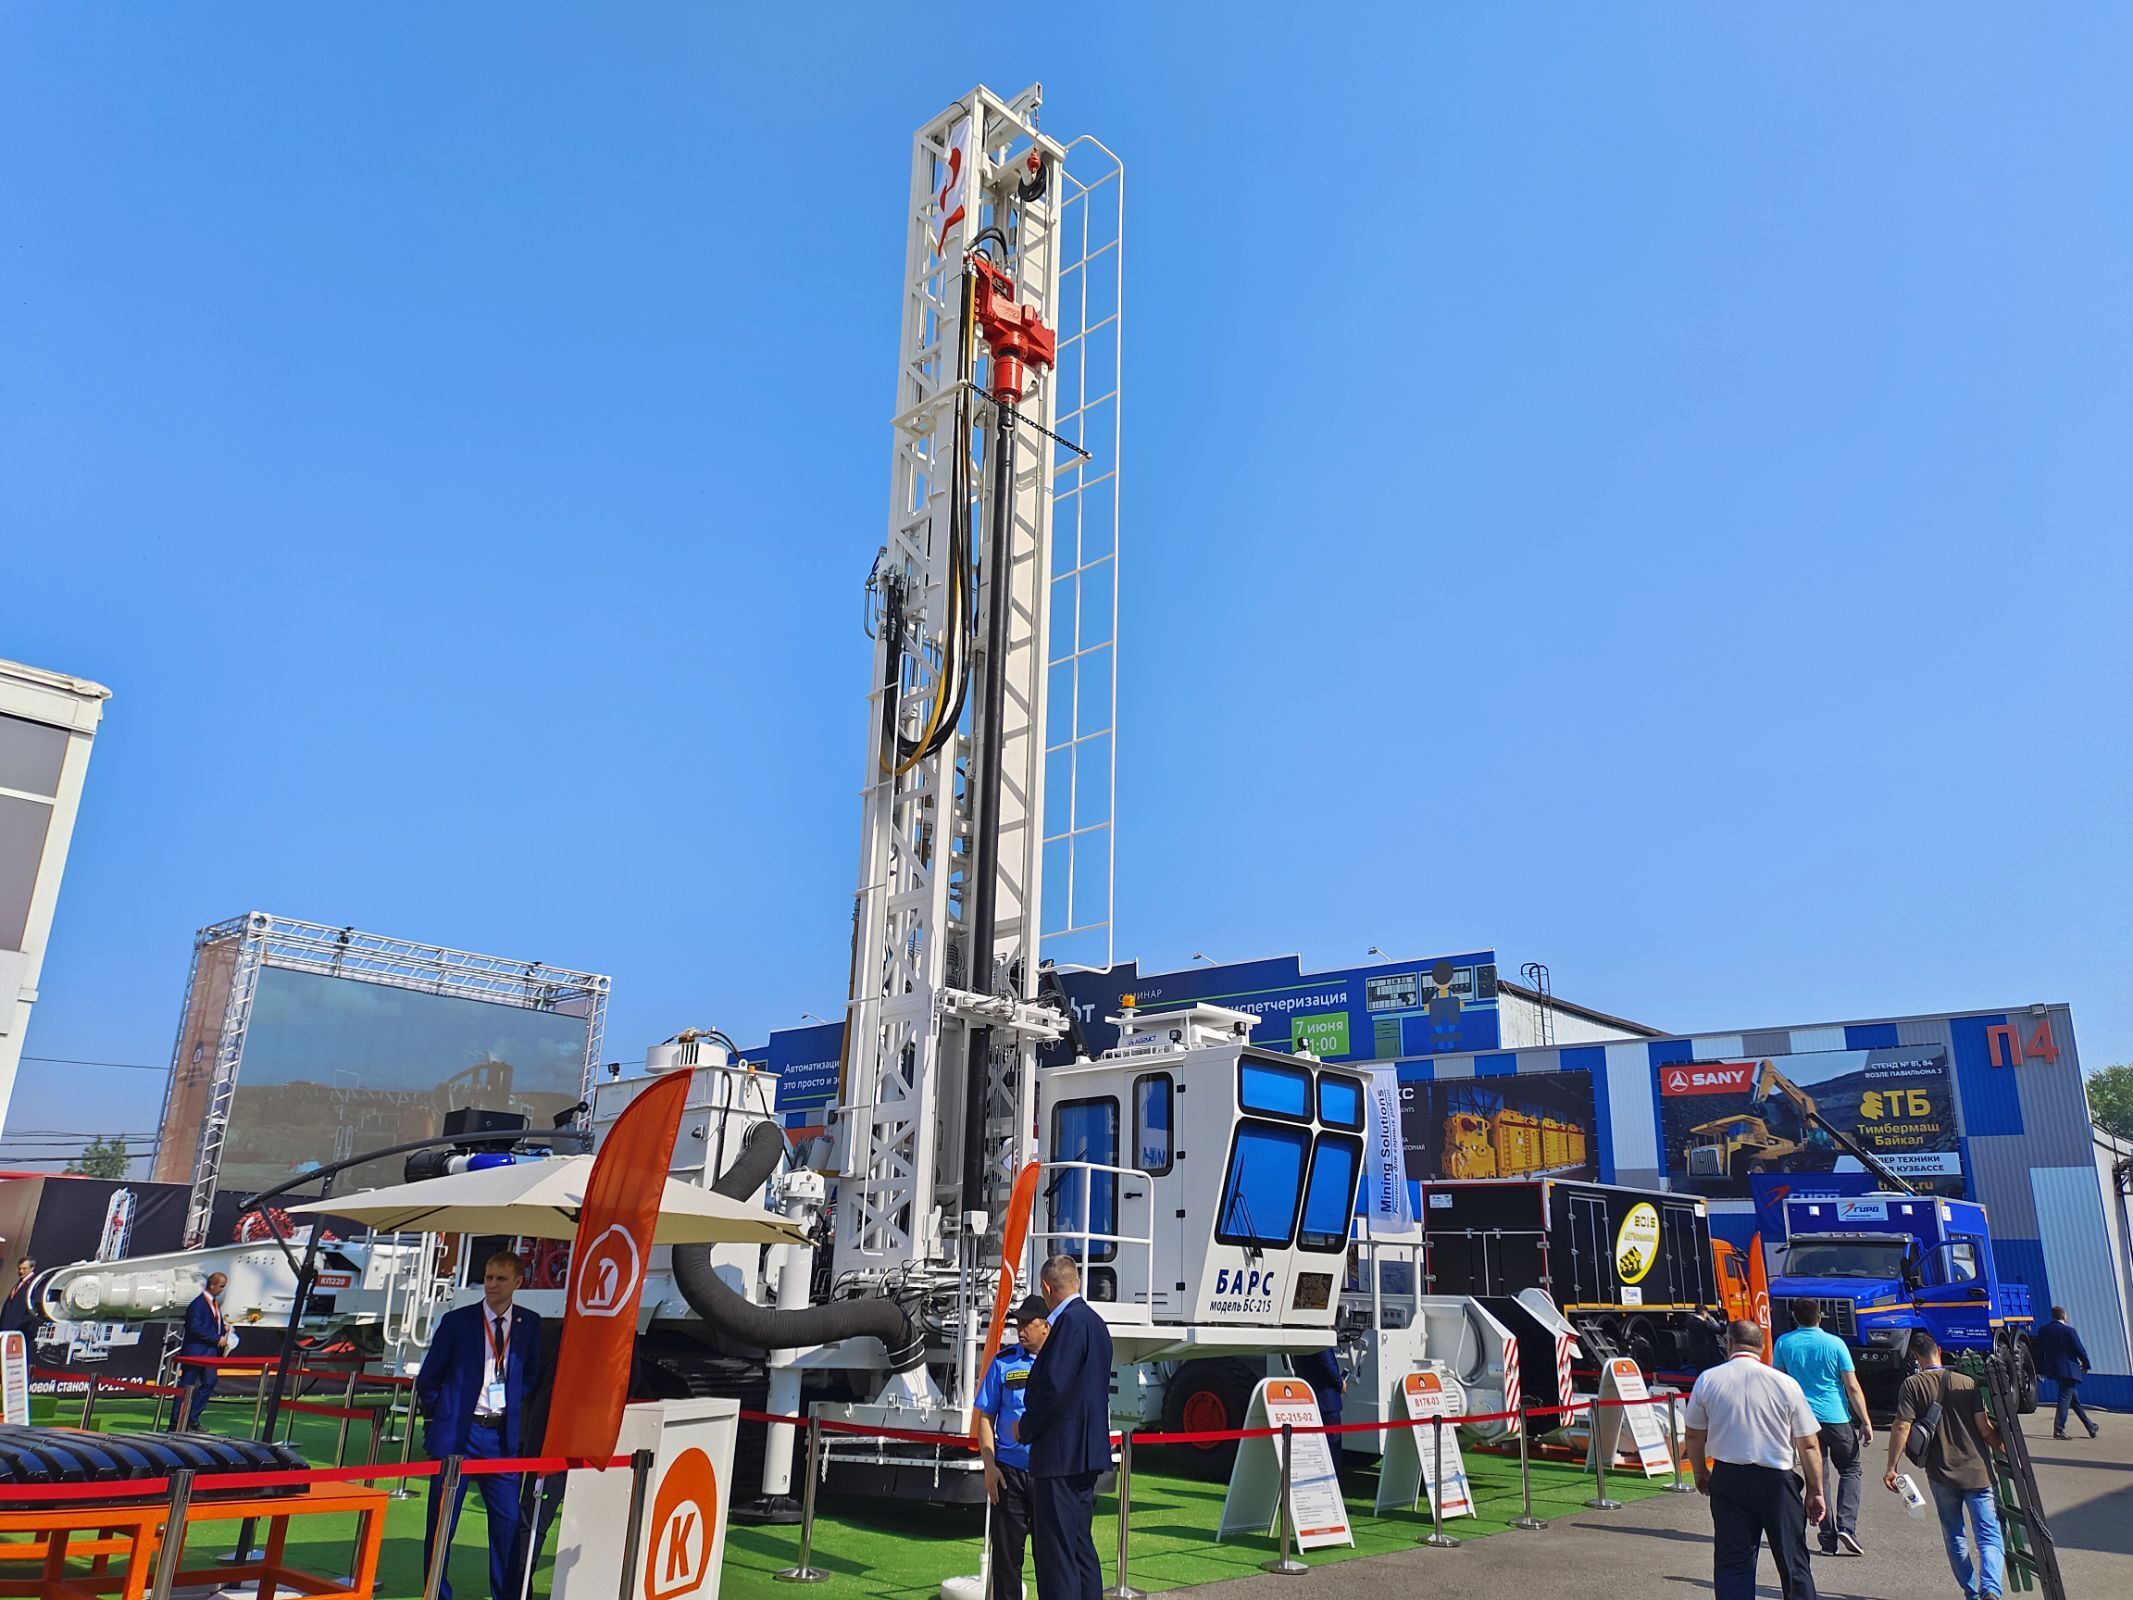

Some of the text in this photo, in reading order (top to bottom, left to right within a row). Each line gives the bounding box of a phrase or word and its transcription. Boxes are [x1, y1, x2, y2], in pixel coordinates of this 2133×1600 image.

[1118, 989, 1162, 1003] СМИНАР
[1226, 992, 1347, 1014] испетчеризация
[1296, 1021, 1343, 1035] 7 июня
[1309, 1036, 1337, 1053] 1:00
[1986, 1021, 2060, 1067] П4
[784, 1060, 841, 1074] Автоматизаци
[1871, 1062, 1899, 1070] СТЕНД
[1692, 1070, 1744, 1086] SANY
[1865, 1071, 1889, 1079] ВОЗЛЕ
[1890, 1069, 1936, 1077] ПАВИЛЬОНА
[783, 1081, 796, 1090] это
[797, 1078, 825, 1091] просто
[826, 1077, 832, 1085] и
[1883, 1089, 1931, 1117] ТБ
[1857, 1123, 1939, 1135] Тимбермаш
[1875, 1135, 1924, 1146] Байкал
[1377, 1089, 1393, 1213] Mining Solutions
[1897, 1155, 1940, 1164] ТЕХНИКИ
[1896, 1164, 1944, 1173] КУЗБАССЕ
[320, 1277, 346, 1286] КП220
[1216, 1268, 1275, 1296] БАРС
[1209, 1298, 1272, 1315] модель БС-215
[1275, 1412, 1313, 1423] БС-215-02
